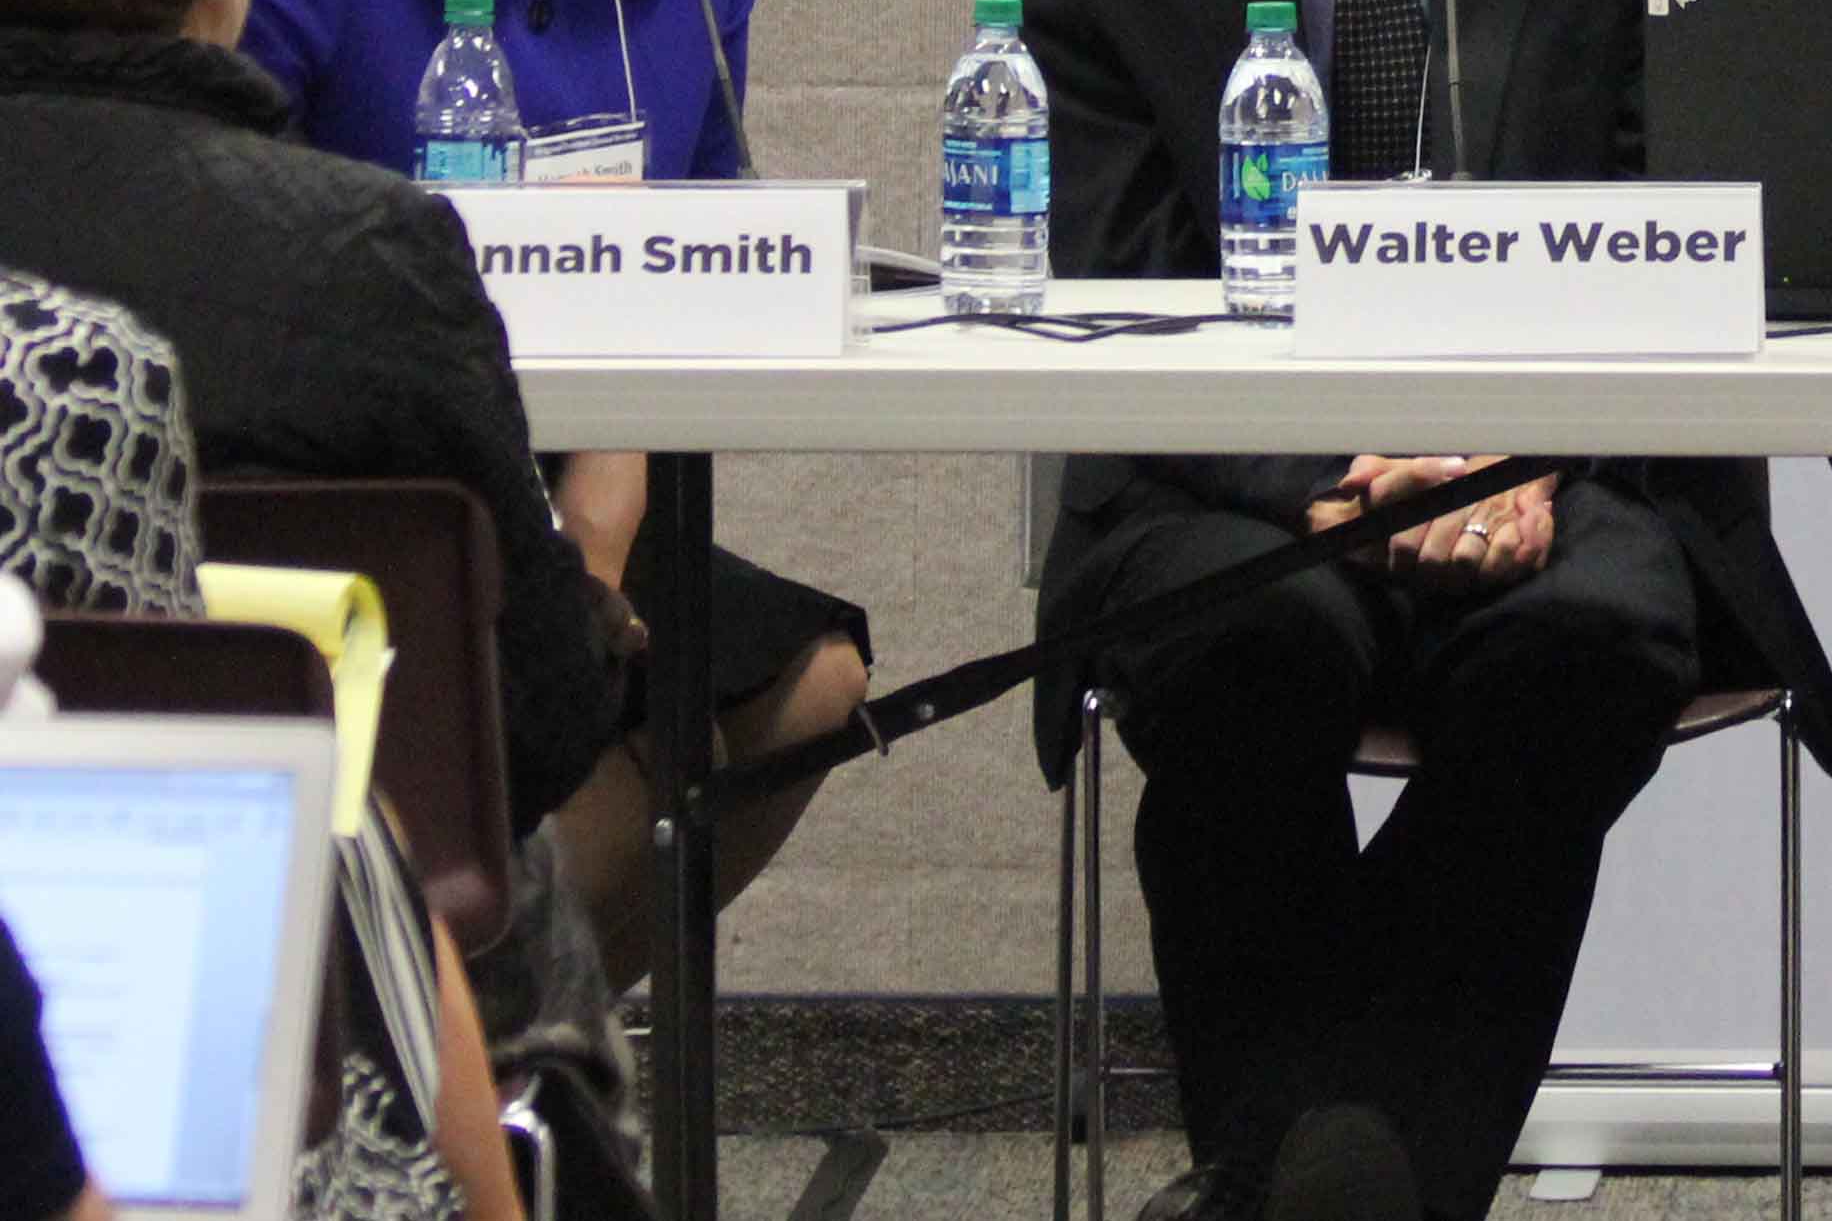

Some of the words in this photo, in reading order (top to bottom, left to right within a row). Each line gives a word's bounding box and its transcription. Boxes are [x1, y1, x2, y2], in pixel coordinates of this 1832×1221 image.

[481, 235, 622, 274] nnah
[642, 234, 812, 274] Smith
[1310, 222, 1519, 264] Walter
[1539, 221, 1747, 263] Weber
